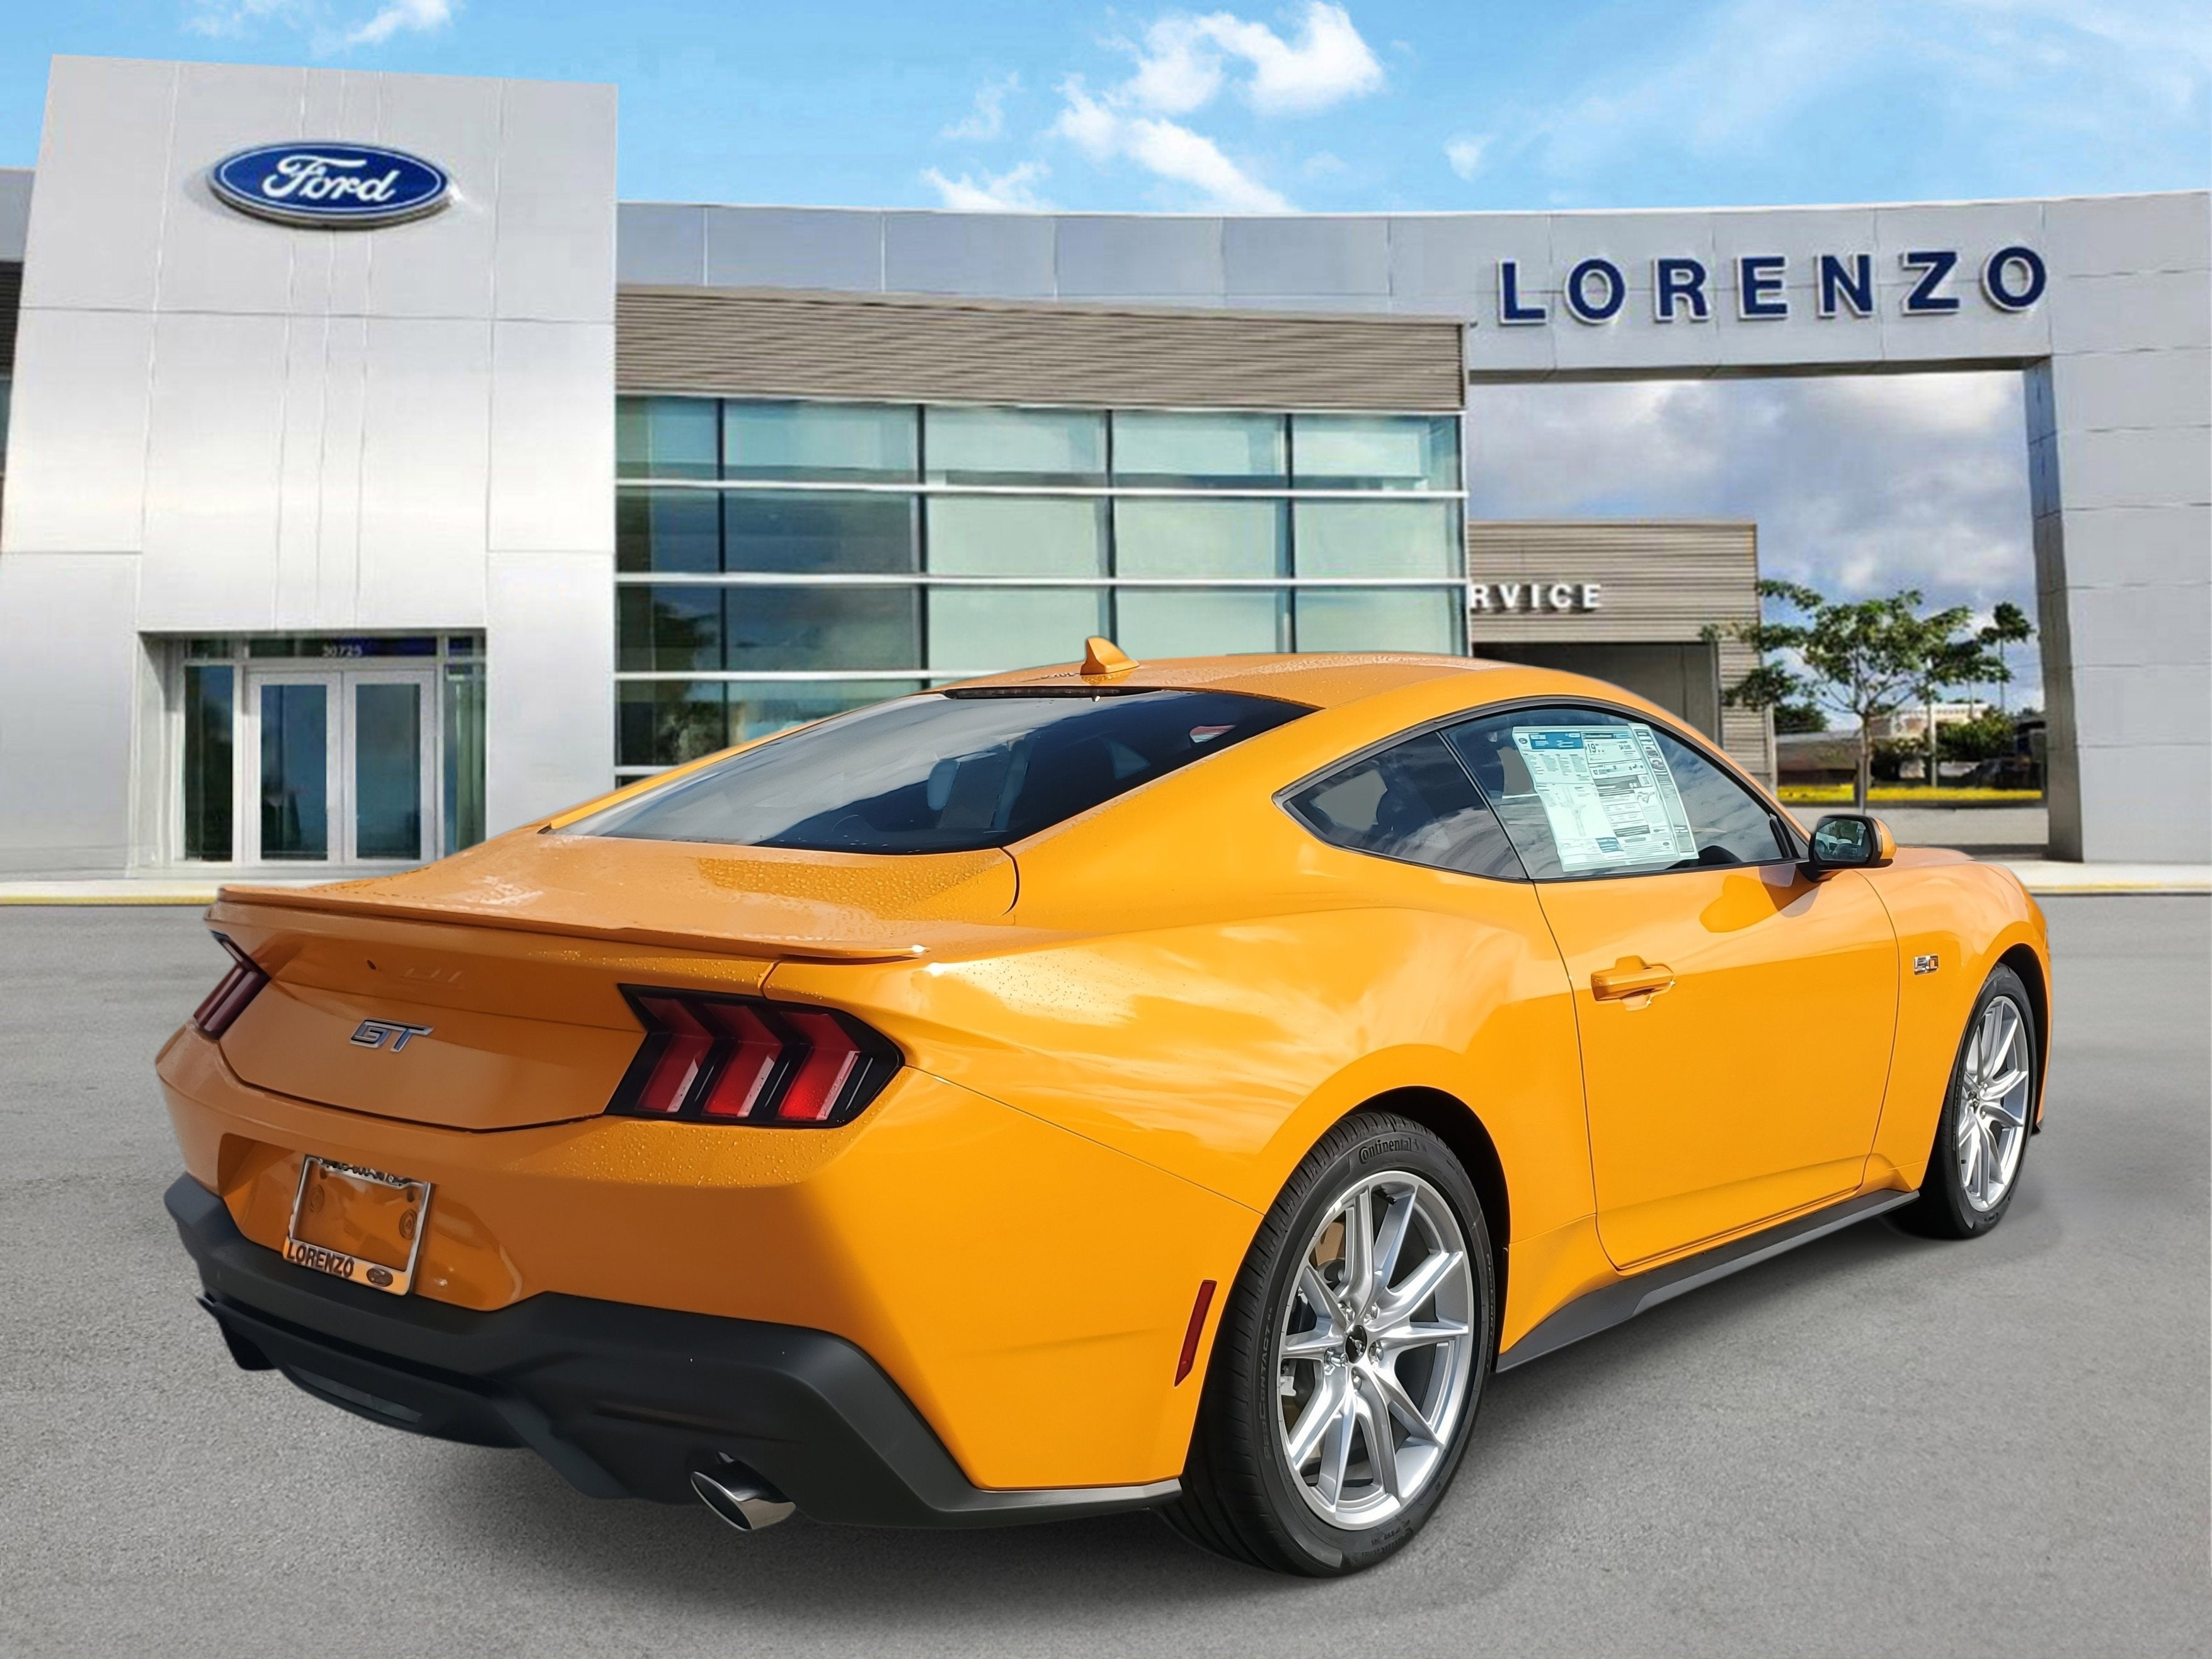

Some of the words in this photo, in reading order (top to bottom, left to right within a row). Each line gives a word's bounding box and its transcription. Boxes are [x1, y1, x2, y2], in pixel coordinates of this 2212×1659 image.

[262, 154, 400, 202] Ford
[1497, 246, 2048, 326] LORENZO
[350, 1018, 434, 1053] GT
[1358, 1137, 1412, 1165] Continental
[287, 1241, 355, 1278] LORENZO
